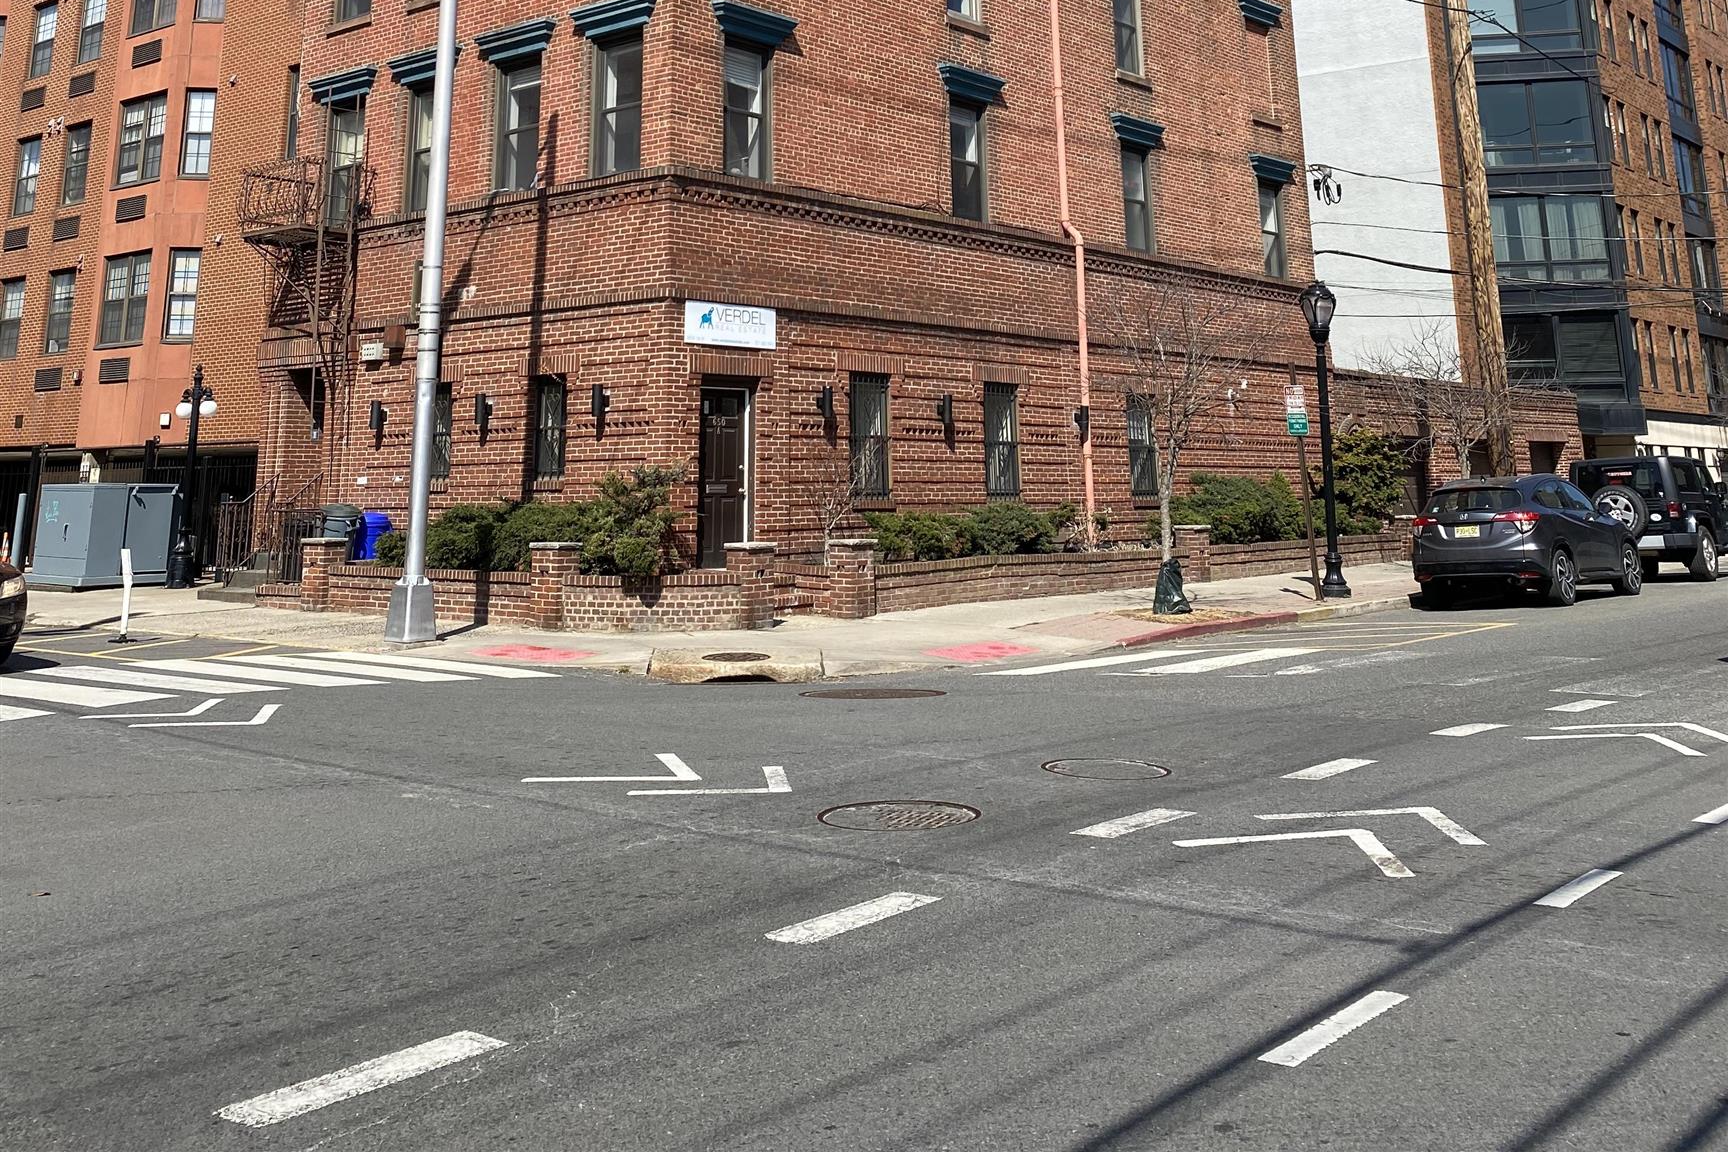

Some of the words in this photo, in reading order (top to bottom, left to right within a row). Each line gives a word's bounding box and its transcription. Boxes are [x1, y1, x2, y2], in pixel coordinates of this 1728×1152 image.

[716, 308, 767, 325] VERDEL
[715, 323, 735, 332] REAL
[712, 417, 726, 426] 650
